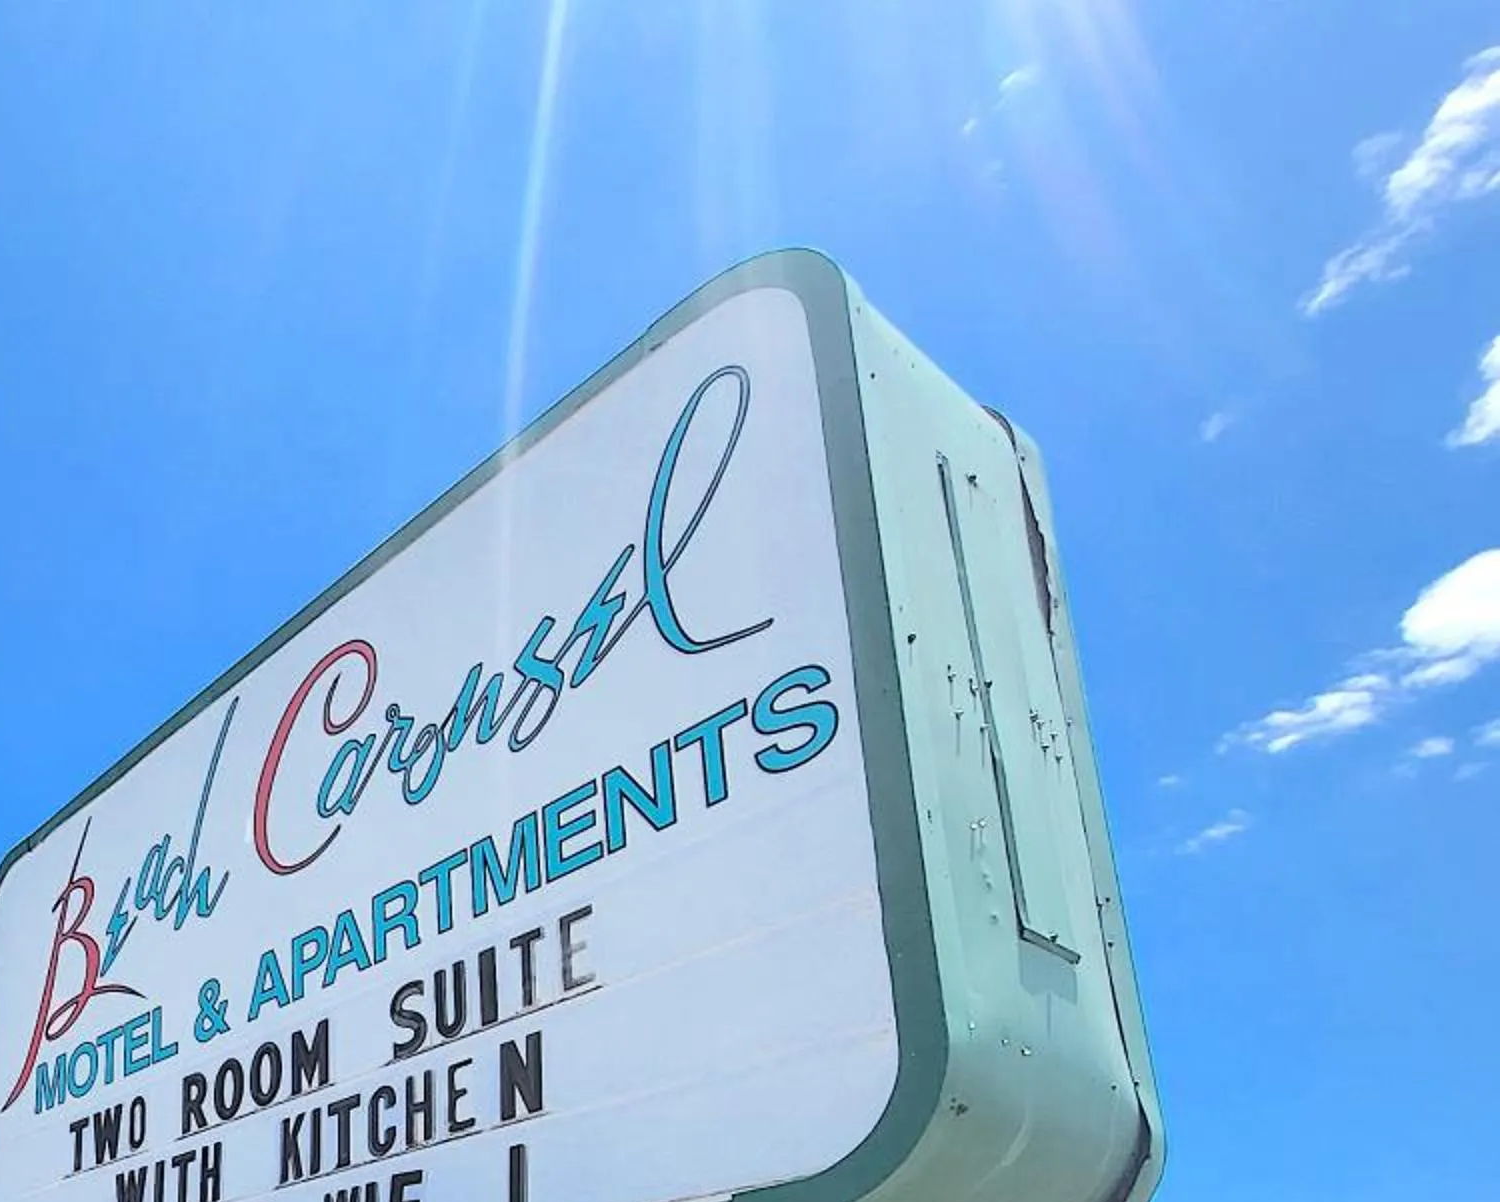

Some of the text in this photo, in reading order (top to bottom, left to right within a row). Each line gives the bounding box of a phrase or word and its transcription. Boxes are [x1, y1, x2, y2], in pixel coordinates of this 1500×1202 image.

[1, 365, 773, 1113] Beach Carousel
[34, 664, 840, 1115] MOTEL & APARTMENTS
[69, 904, 596, 1173] TWO ROOM SUITE
